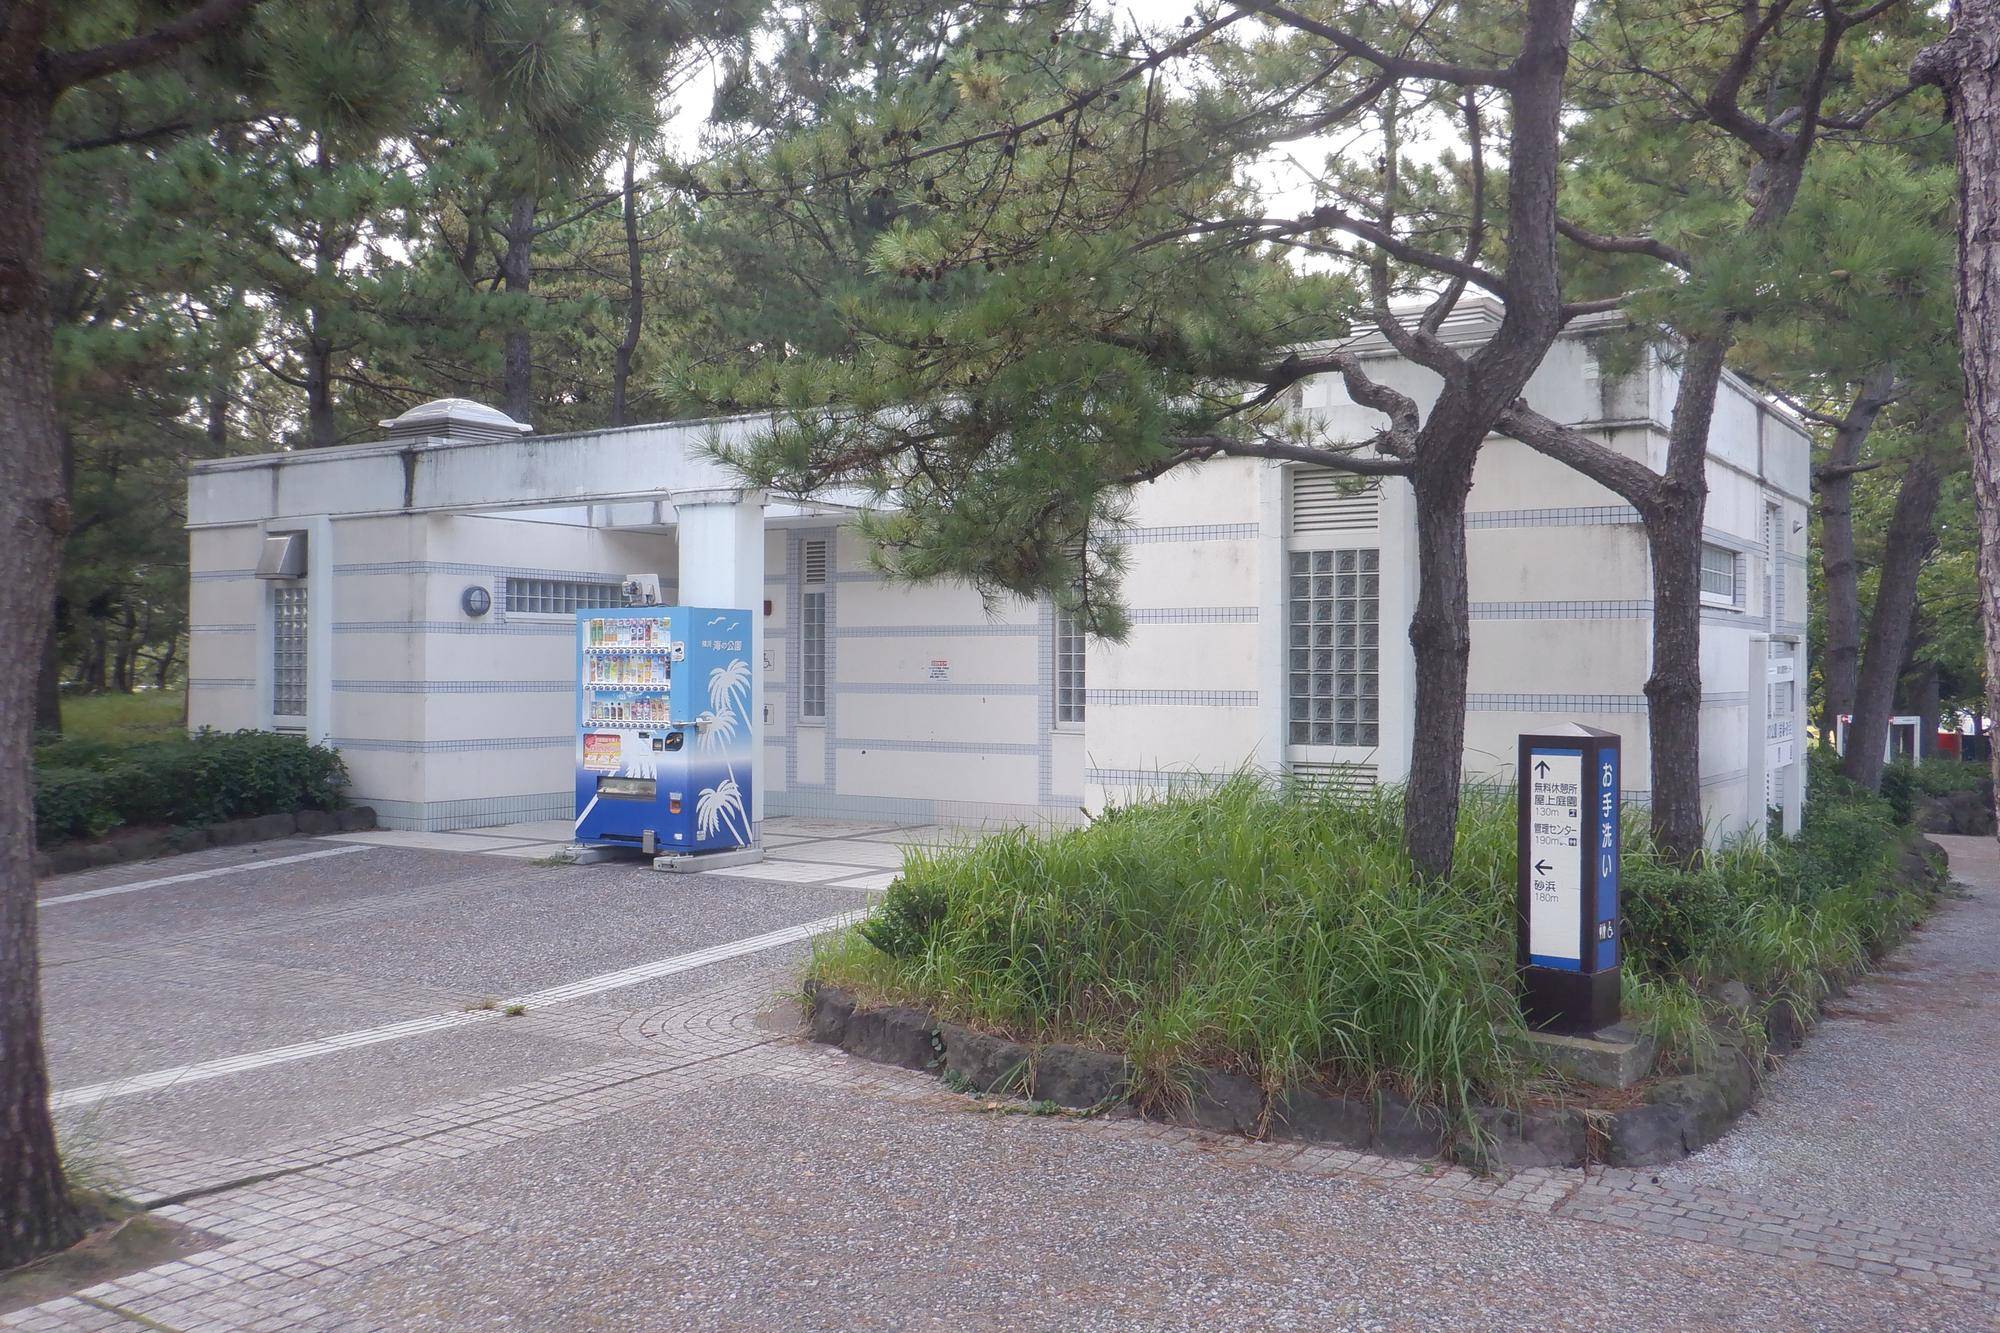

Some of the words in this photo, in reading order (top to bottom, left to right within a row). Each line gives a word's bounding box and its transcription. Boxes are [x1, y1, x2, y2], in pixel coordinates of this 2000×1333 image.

[1534, 782, 1578, 795] 無料休憩所
[1534, 794, 1578, 807] 屋上庭園
[1535, 807, 1560, 817] 130m
[1602, 762, 1613, 878] お手洗い
[1534, 822, 1577, 835] 管理センター
[1535, 835, 1559, 846] 190m
[1534, 879, 1556, 892] 砂浜
[1535, 892, 1559, 903] 180m
